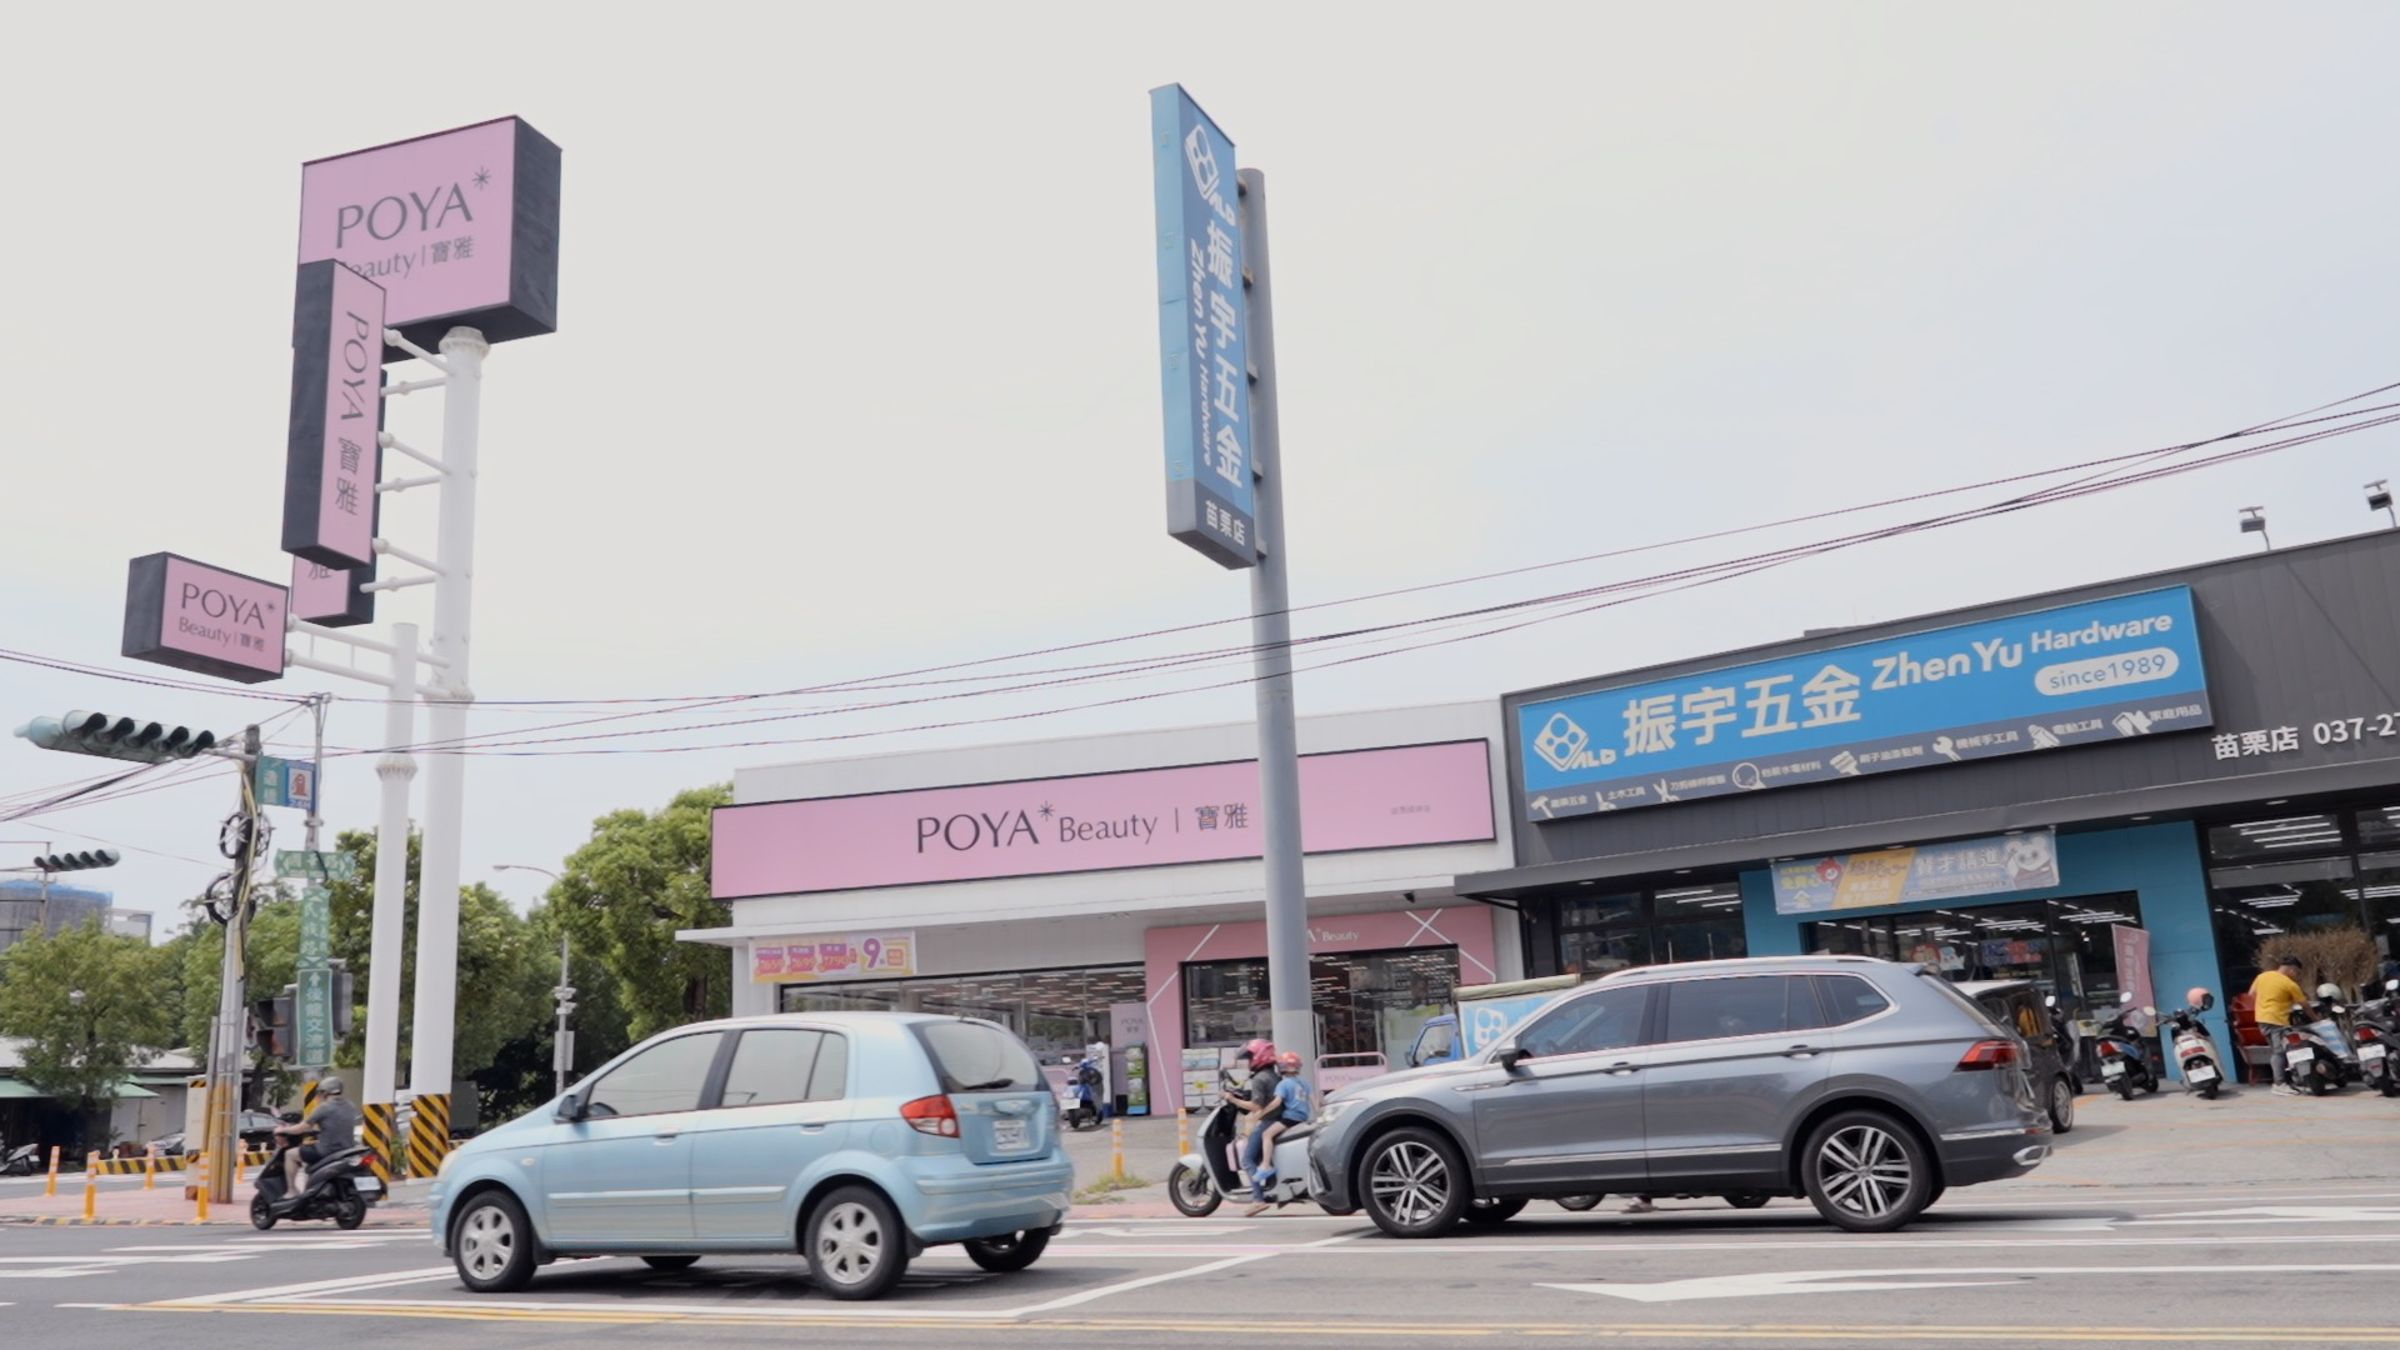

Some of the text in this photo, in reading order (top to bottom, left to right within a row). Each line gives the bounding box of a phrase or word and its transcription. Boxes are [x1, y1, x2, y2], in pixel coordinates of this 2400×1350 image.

[336, 182, 473, 249] POYA
[345, 235, 475, 279] eauty 寶雅
[1206, 219, 1243, 488] 振宇五金
[334, 310, 370, 517] POYA 寶雅
[1199, 363, 1212, 467] Hardware
[1205, 499, 1246, 547] 苗栗店
[181, 582, 265, 630] POYA
[178, 616, 232, 648] Beauty
[1622, 664, 1862, 757] 振宇五金
[2030, 614, 2173, 653] Hardware
[2211, 726, 2299, 760] 苗栗店
[917, 802, 1249, 853] POYA Beauty 寶雅
